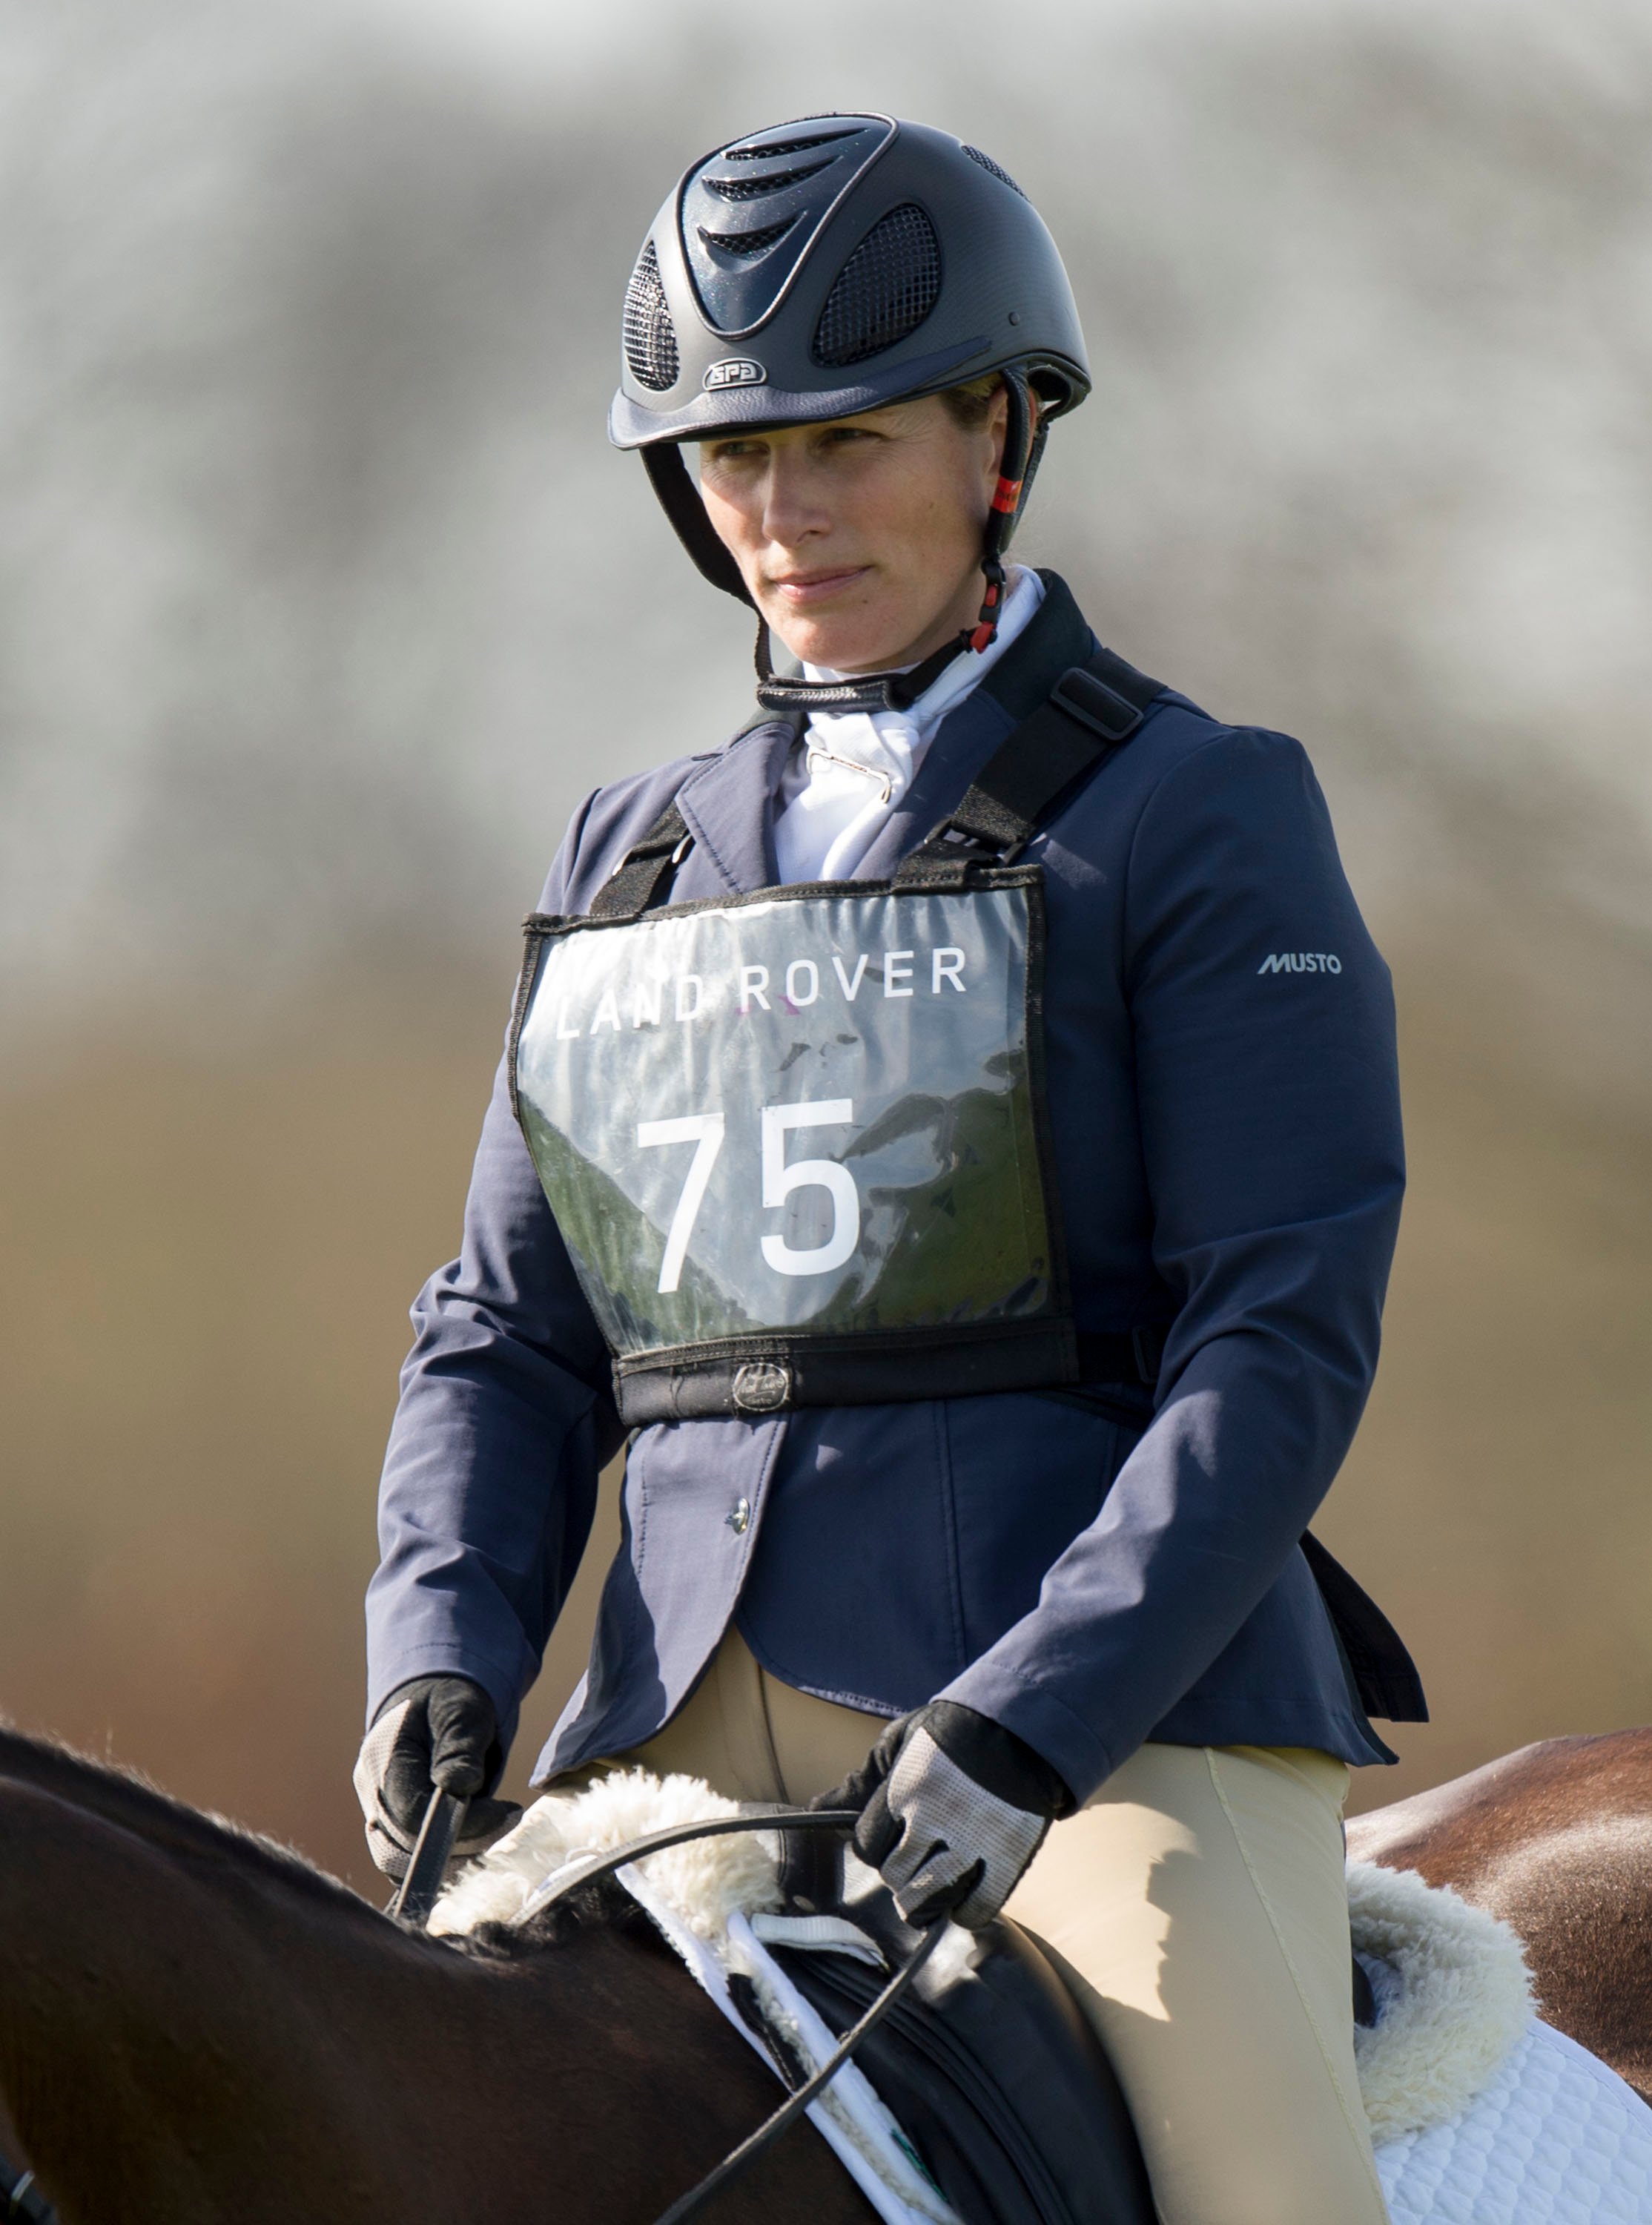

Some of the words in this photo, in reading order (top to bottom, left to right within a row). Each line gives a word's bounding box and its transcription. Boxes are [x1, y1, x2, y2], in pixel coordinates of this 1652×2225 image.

[556, 974, 704, 1040] LAND
[740, 947, 966, 1013] ROVER
[1257, 953, 1342, 975] MUSTO
[636, 1098, 860, 1293] 75
